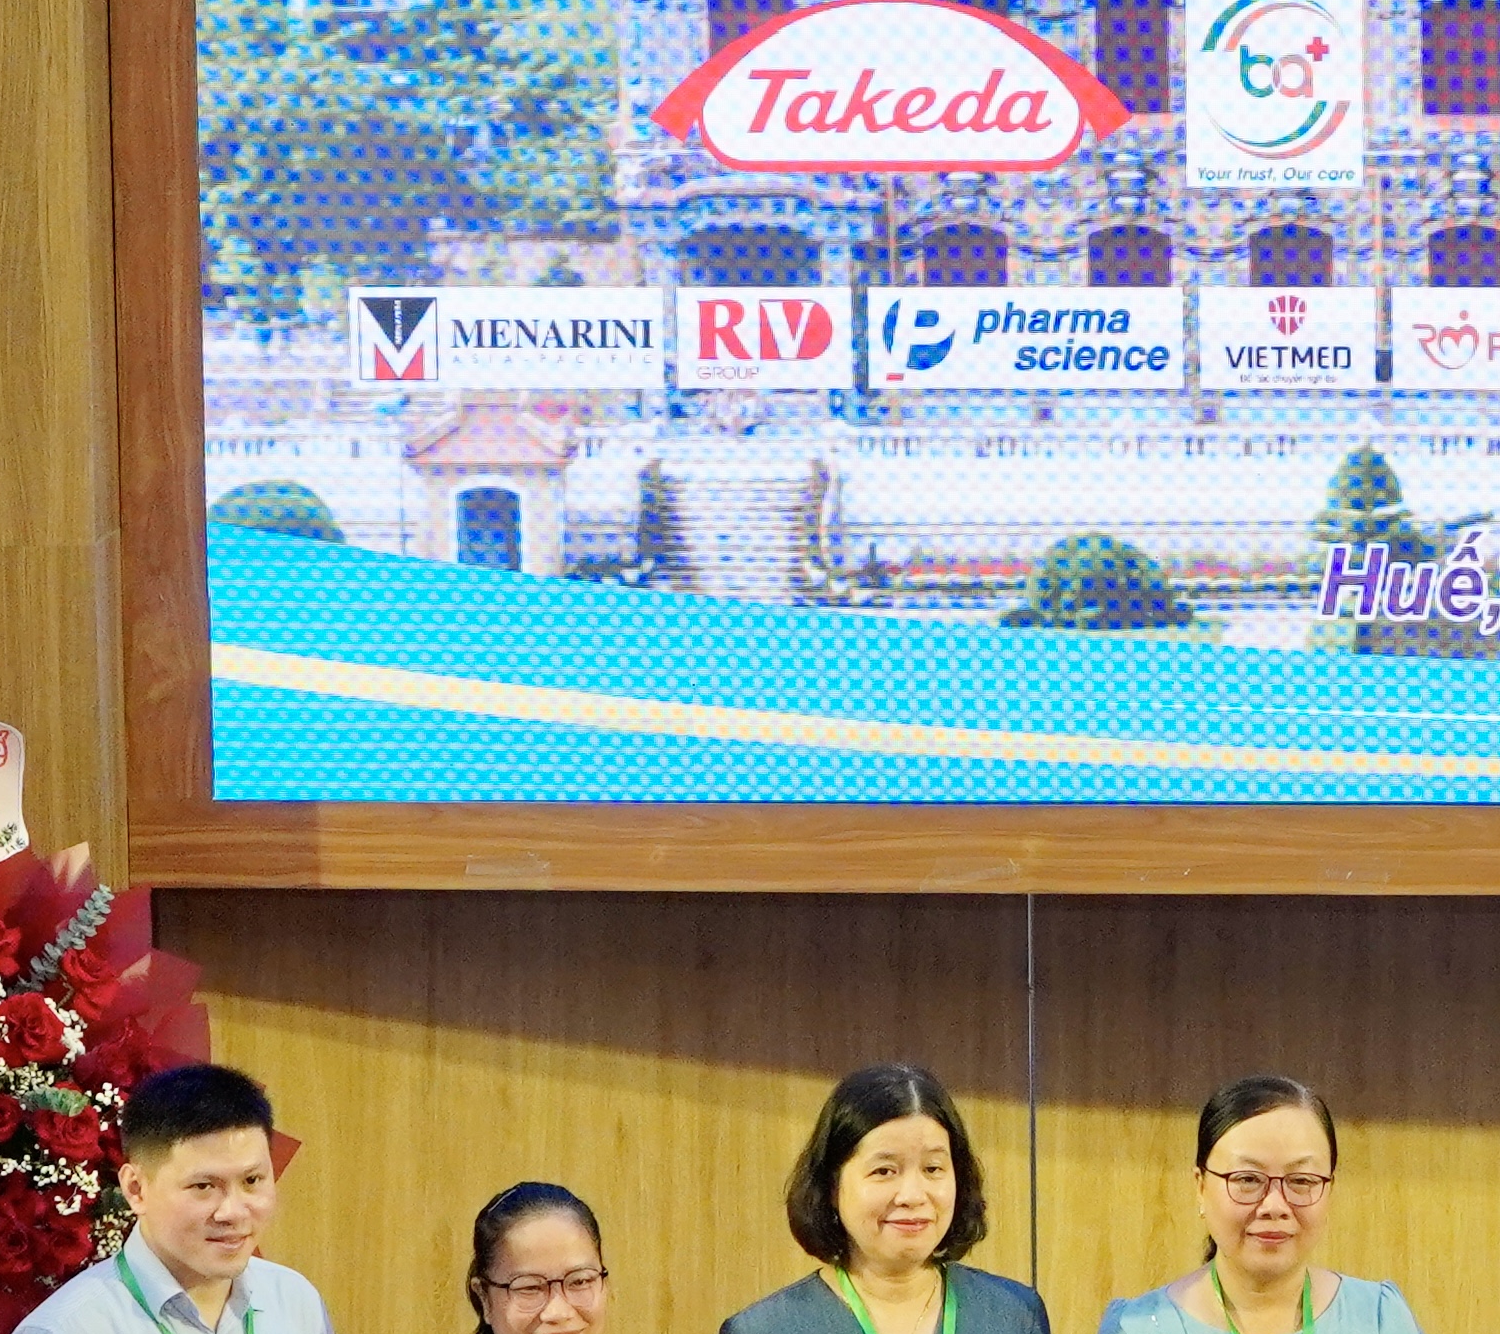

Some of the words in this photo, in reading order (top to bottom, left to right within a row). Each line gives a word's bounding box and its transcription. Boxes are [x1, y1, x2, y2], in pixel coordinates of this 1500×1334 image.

[744, 67, 1051, 138] Takeda
[1198, 167, 1231, 181] Your
[1238, 167, 1276, 183] trust,
[1284, 167, 1312, 181] Our
[1318, 170, 1355, 181] care
[450, 319, 654, 348] MENARINI
[973, 302, 1129, 342] pharma
[452, 354, 652, 364] ASIA-PACIFIC
[1015, 337, 1170, 371] science
[1225, 346, 1350, 368] VIETMED
[697, 366, 758, 379] GROUP
